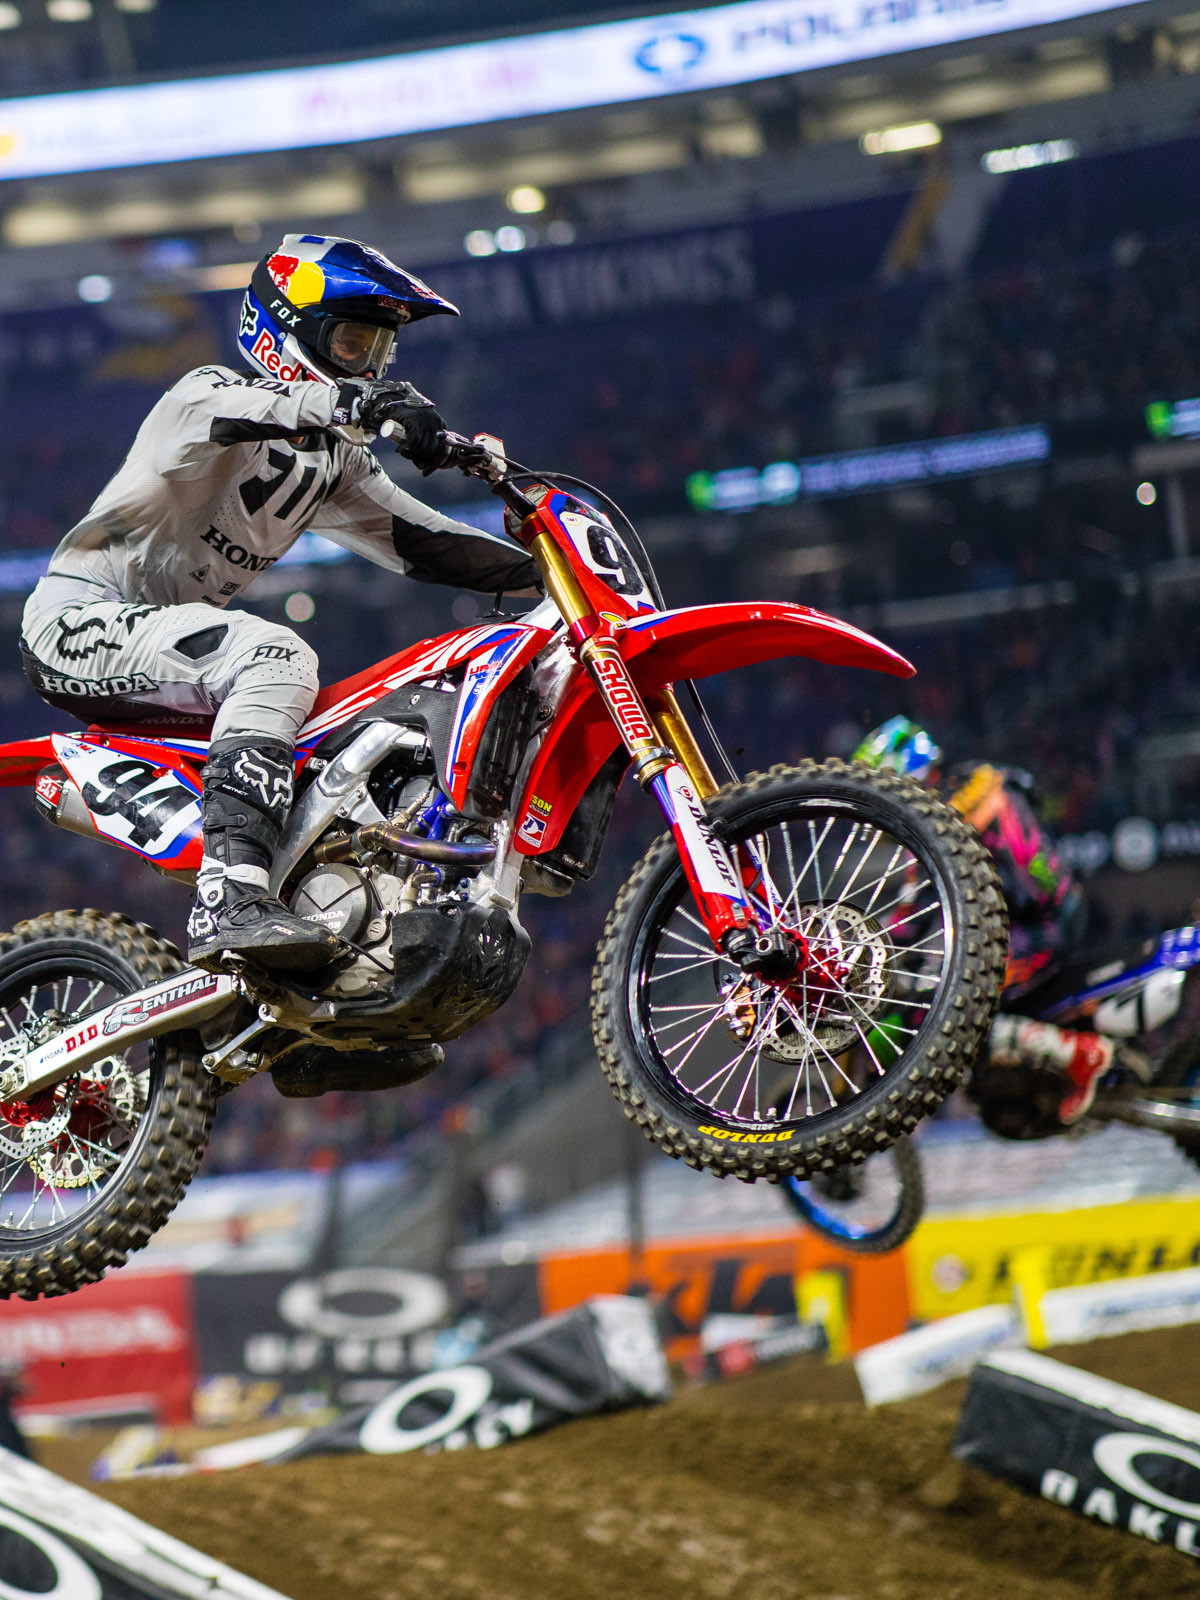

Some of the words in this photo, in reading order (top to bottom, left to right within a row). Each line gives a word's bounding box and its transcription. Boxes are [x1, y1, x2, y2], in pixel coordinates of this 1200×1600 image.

[269, 299, 302, 328] FOX
[252, 645, 300, 663] FOX
[40, 672, 159, 698] HONDA
[592, 657, 654, 743] SHOWA
[140, 715, 205, 726] HONDA
[81, 759, 201, 849] 94
[697, 1125, 796, 1143] DUNLOP
